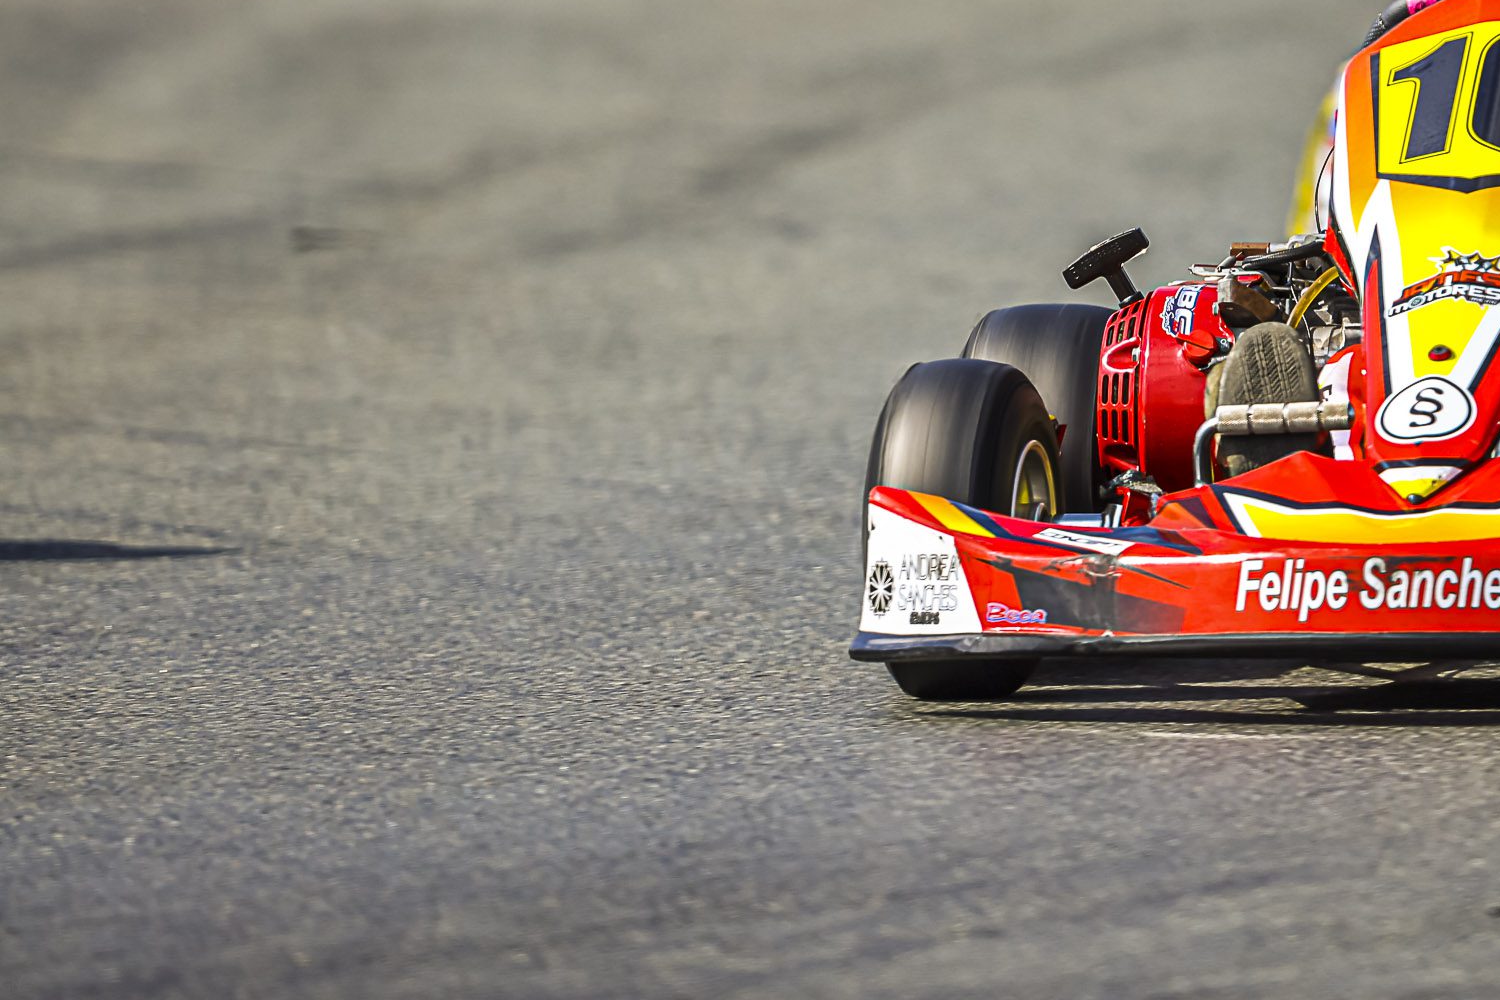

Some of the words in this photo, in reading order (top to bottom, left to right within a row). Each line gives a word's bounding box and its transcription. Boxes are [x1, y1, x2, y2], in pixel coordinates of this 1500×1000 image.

[899, 553, 959, 581] ANDREA
[897, 584, 957, 611] SANCHES
[1235, 559, 1348, 623] Felipe
